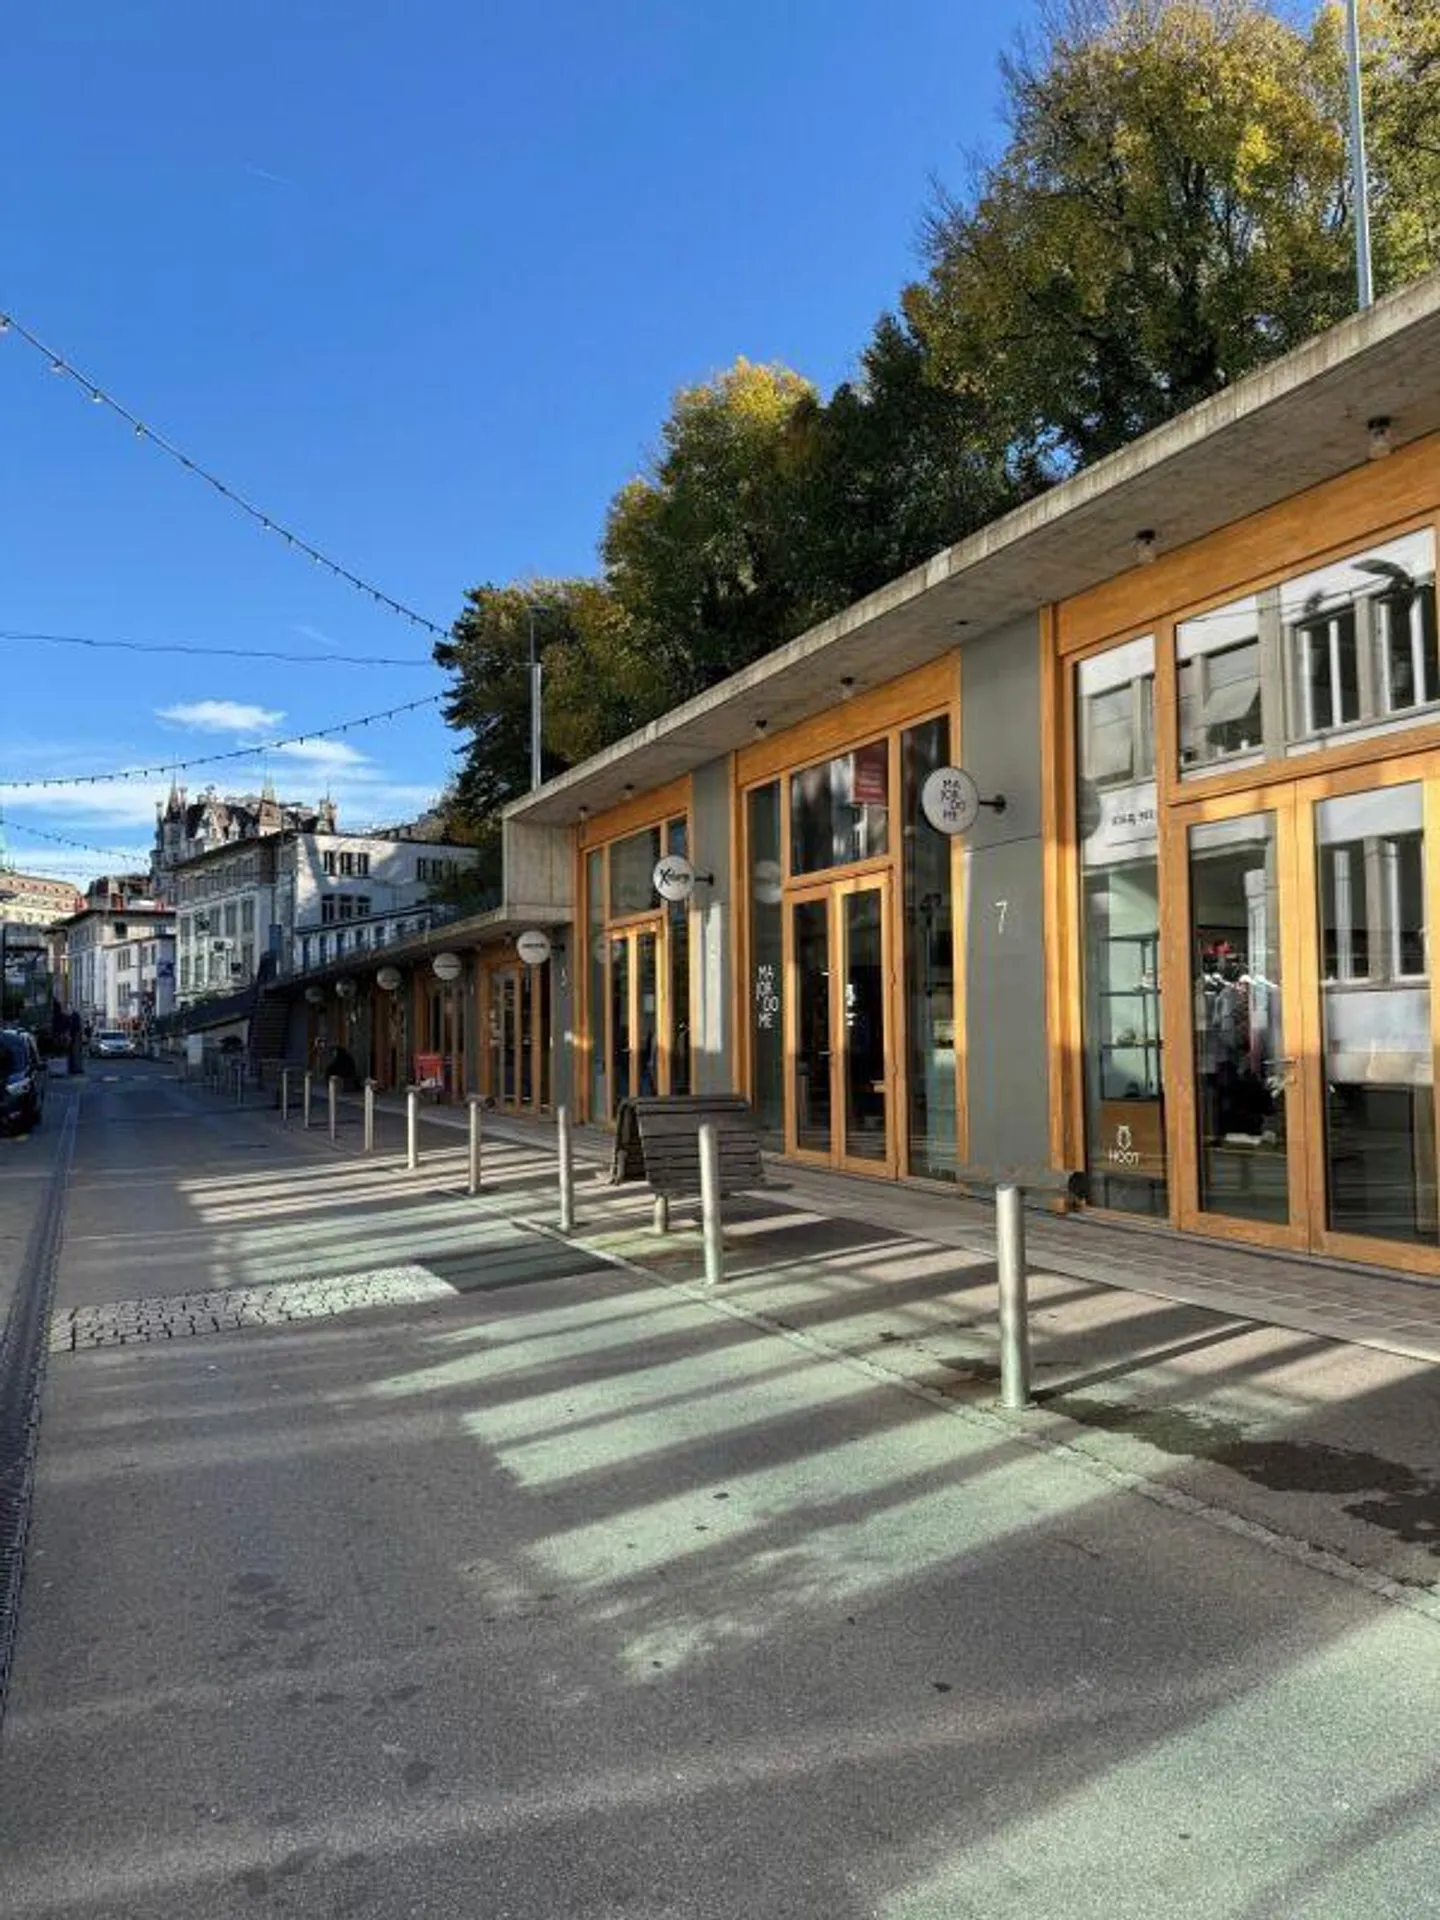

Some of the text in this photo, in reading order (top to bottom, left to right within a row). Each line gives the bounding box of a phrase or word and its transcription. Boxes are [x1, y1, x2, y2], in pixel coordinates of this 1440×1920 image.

[995, 899, 1008, 934] 7
[758, 964, 774, 980] MA
[763, 996, 779, 1012] DO
[759, 1012, 773, 1028] ME
